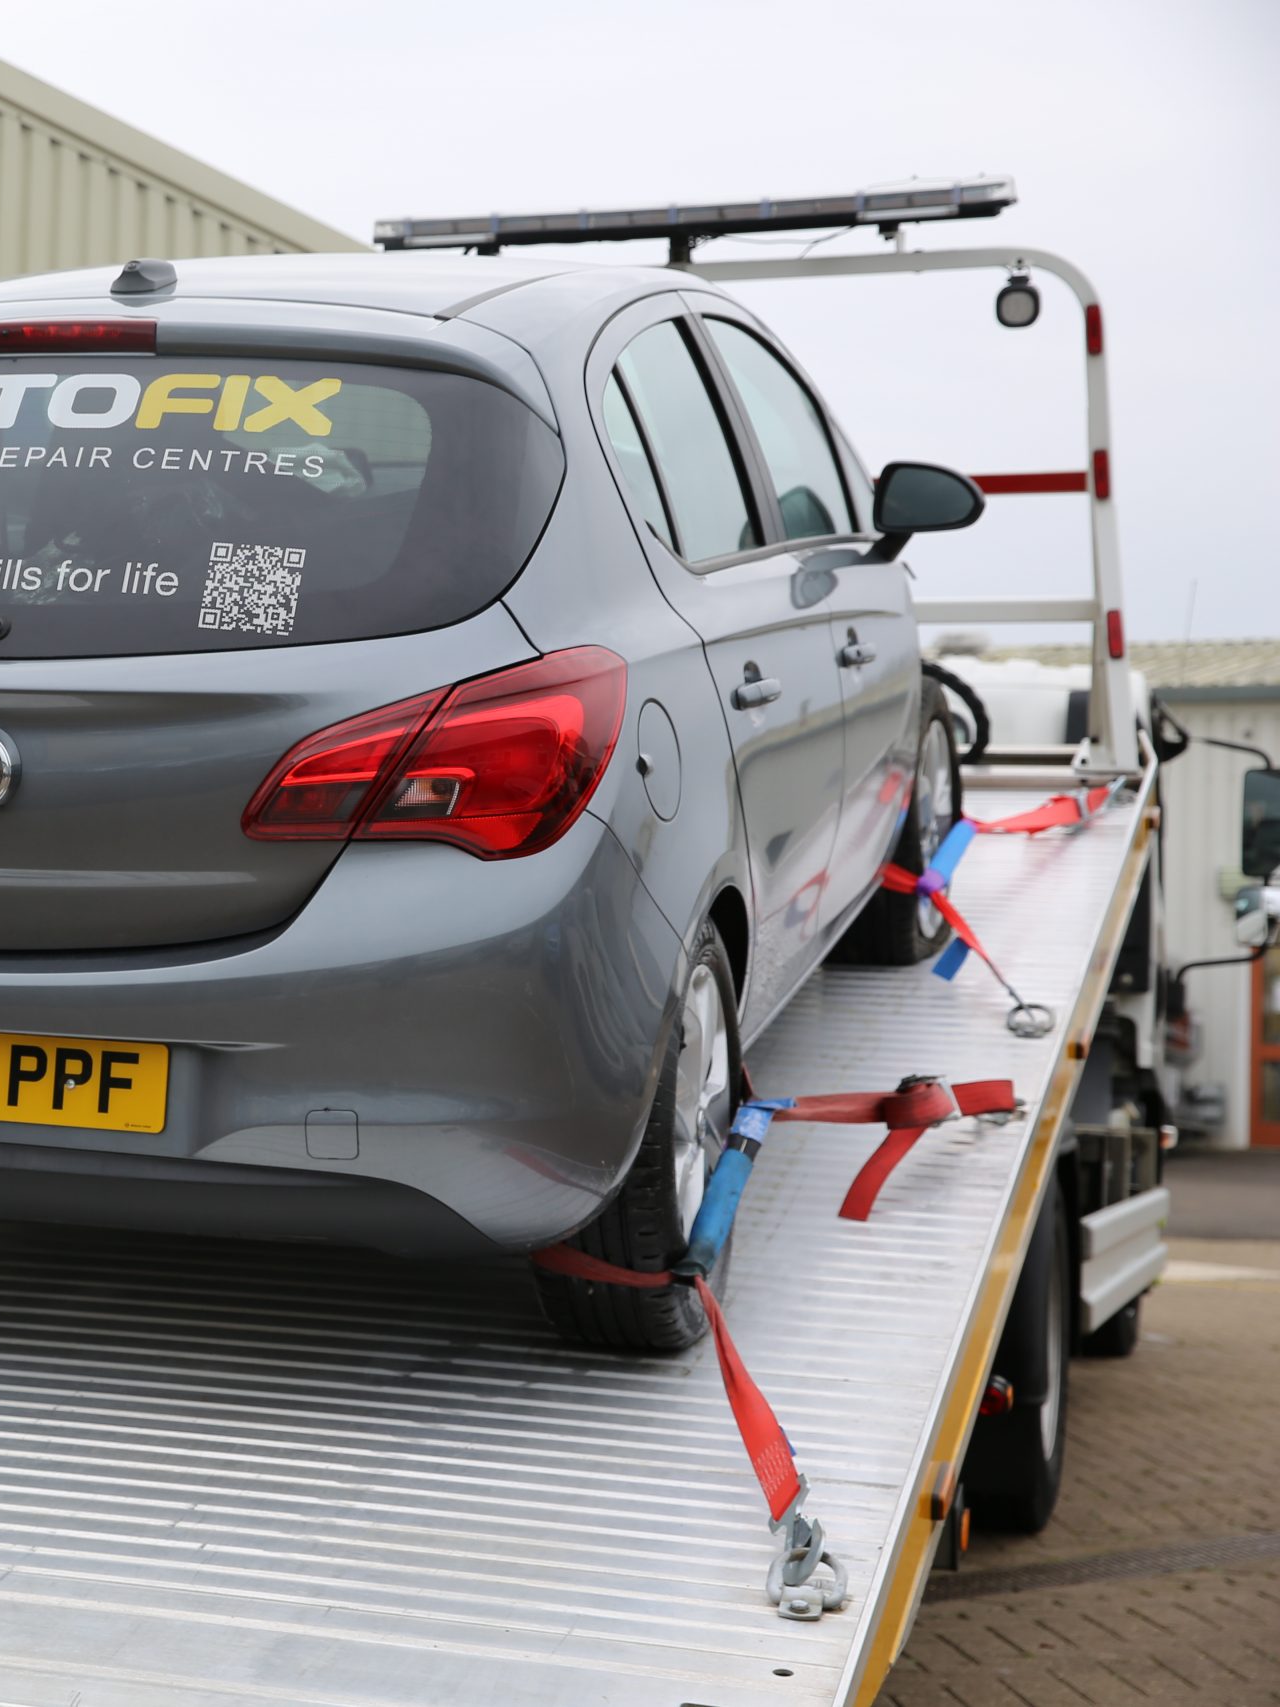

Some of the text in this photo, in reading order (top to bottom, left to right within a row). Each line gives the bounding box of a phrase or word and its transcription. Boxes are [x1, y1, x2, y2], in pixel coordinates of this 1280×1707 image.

[132, 448, 324, 478] CENTRES
[56, 560, 111, 592] for
[121, 562, 179, 596] life
[7, 1044, 140, 1113] PPF
